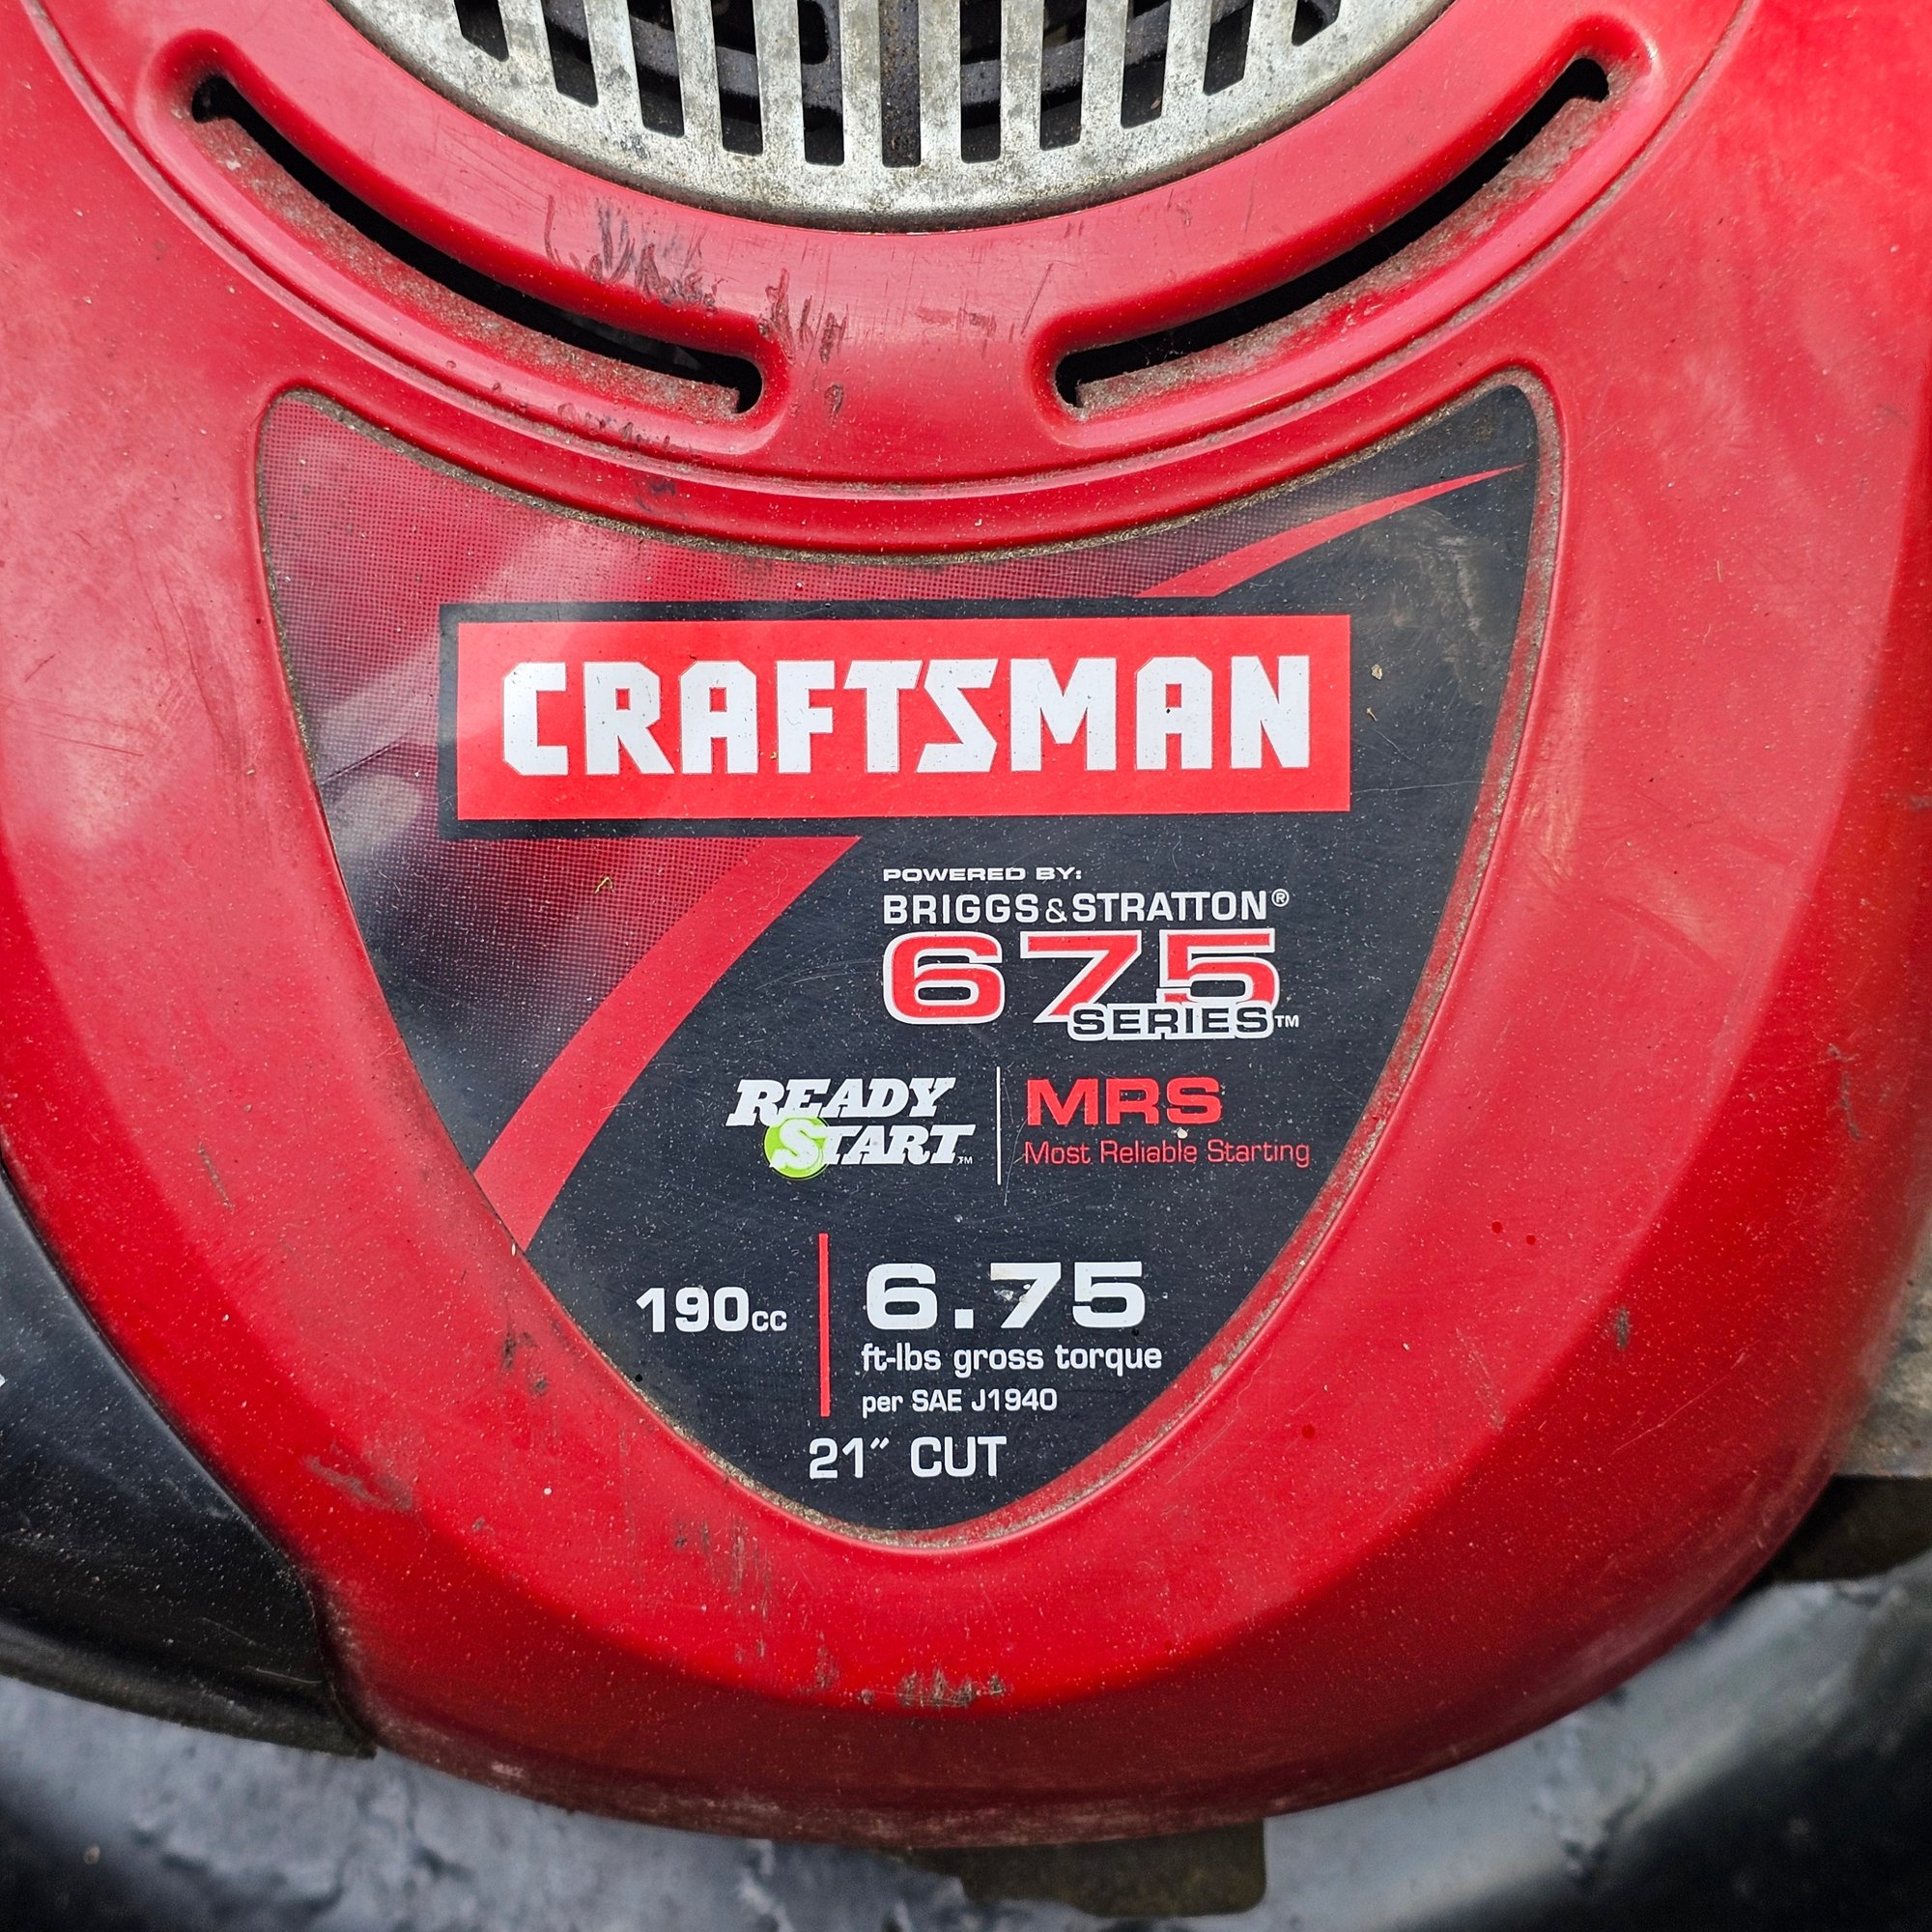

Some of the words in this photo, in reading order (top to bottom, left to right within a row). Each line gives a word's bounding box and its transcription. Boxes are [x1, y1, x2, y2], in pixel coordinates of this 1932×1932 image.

[502, 655, 1311, 777] CRAFTSMAN
[883, 867, 1027, 882] POWERED
[1036, 867, 1083, 881] BY:
[883, 927, 1281, 1025] 675
[726, 1077, 956, 1128] READY
[1026, 1077, 1223, 1126] MRS
[1024, 1141, 1092, 1165] Most
[1100, 1139, 1198, 1165] Reliable
[1207, 1140, 1311, 1168] Starting
[636, 1286, 787, 1333] 190cc
[866, 1260, 1147, 1330] 6.75
[861, 1343, 942, 1372] ft-lbs
[953, 1348, 1044, 1378] gross
[1055, 1345, 1162, 1377] torque
[862, 1394, 904, 1418] per
[911, 1389, 962, 1412] SAE
[971, 1387, 1058, 1412] J1940
[910, 1435, 1008, 1478] CUT
